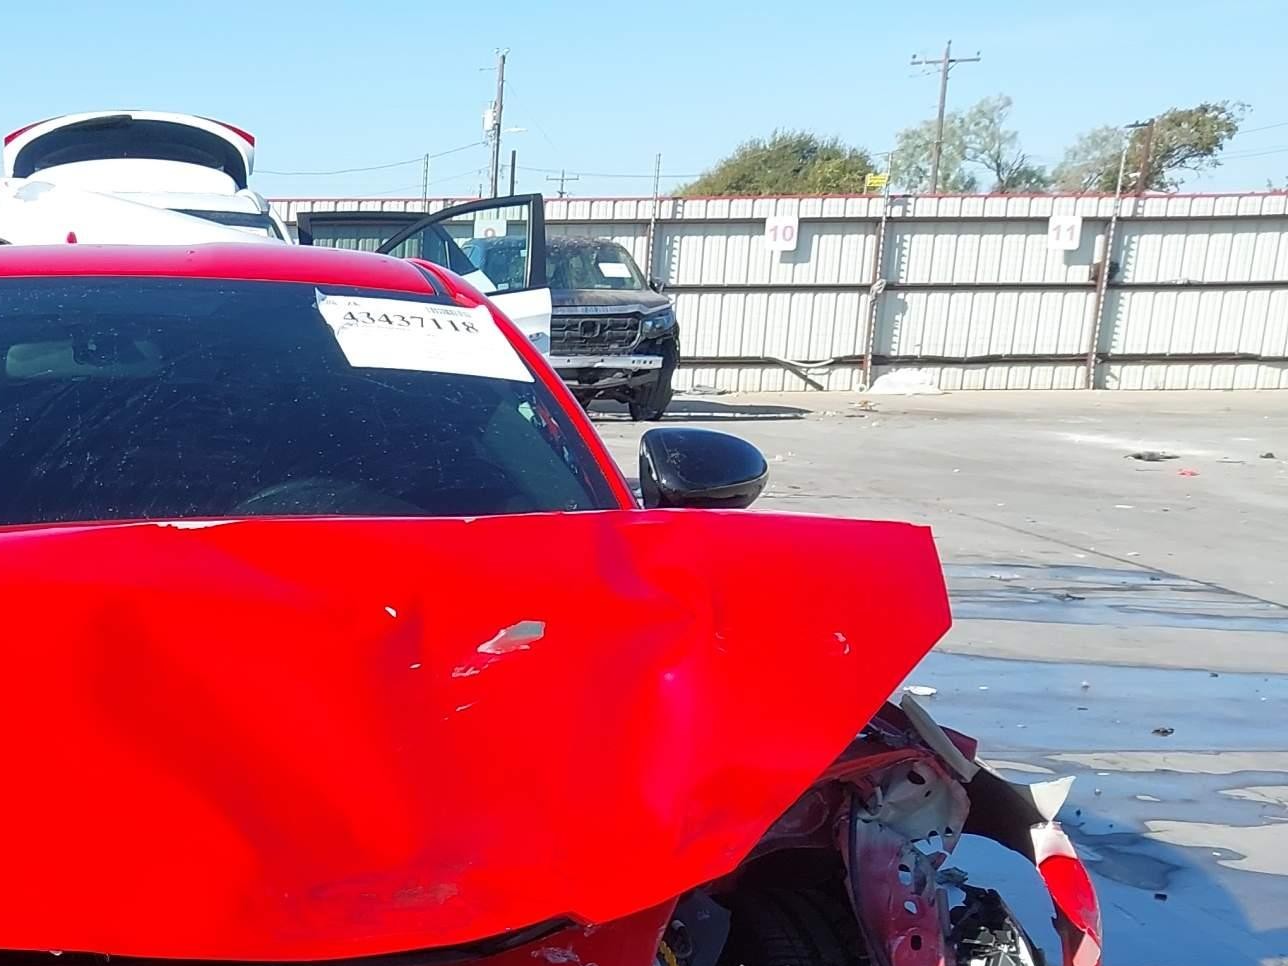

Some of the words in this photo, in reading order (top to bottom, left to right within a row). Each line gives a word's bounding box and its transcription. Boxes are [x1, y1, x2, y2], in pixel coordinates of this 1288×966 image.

[769, 225, 794, 242] 10
[1052, 224, 1075, 241] 11
[343, 311, 479, 333] 43437118
